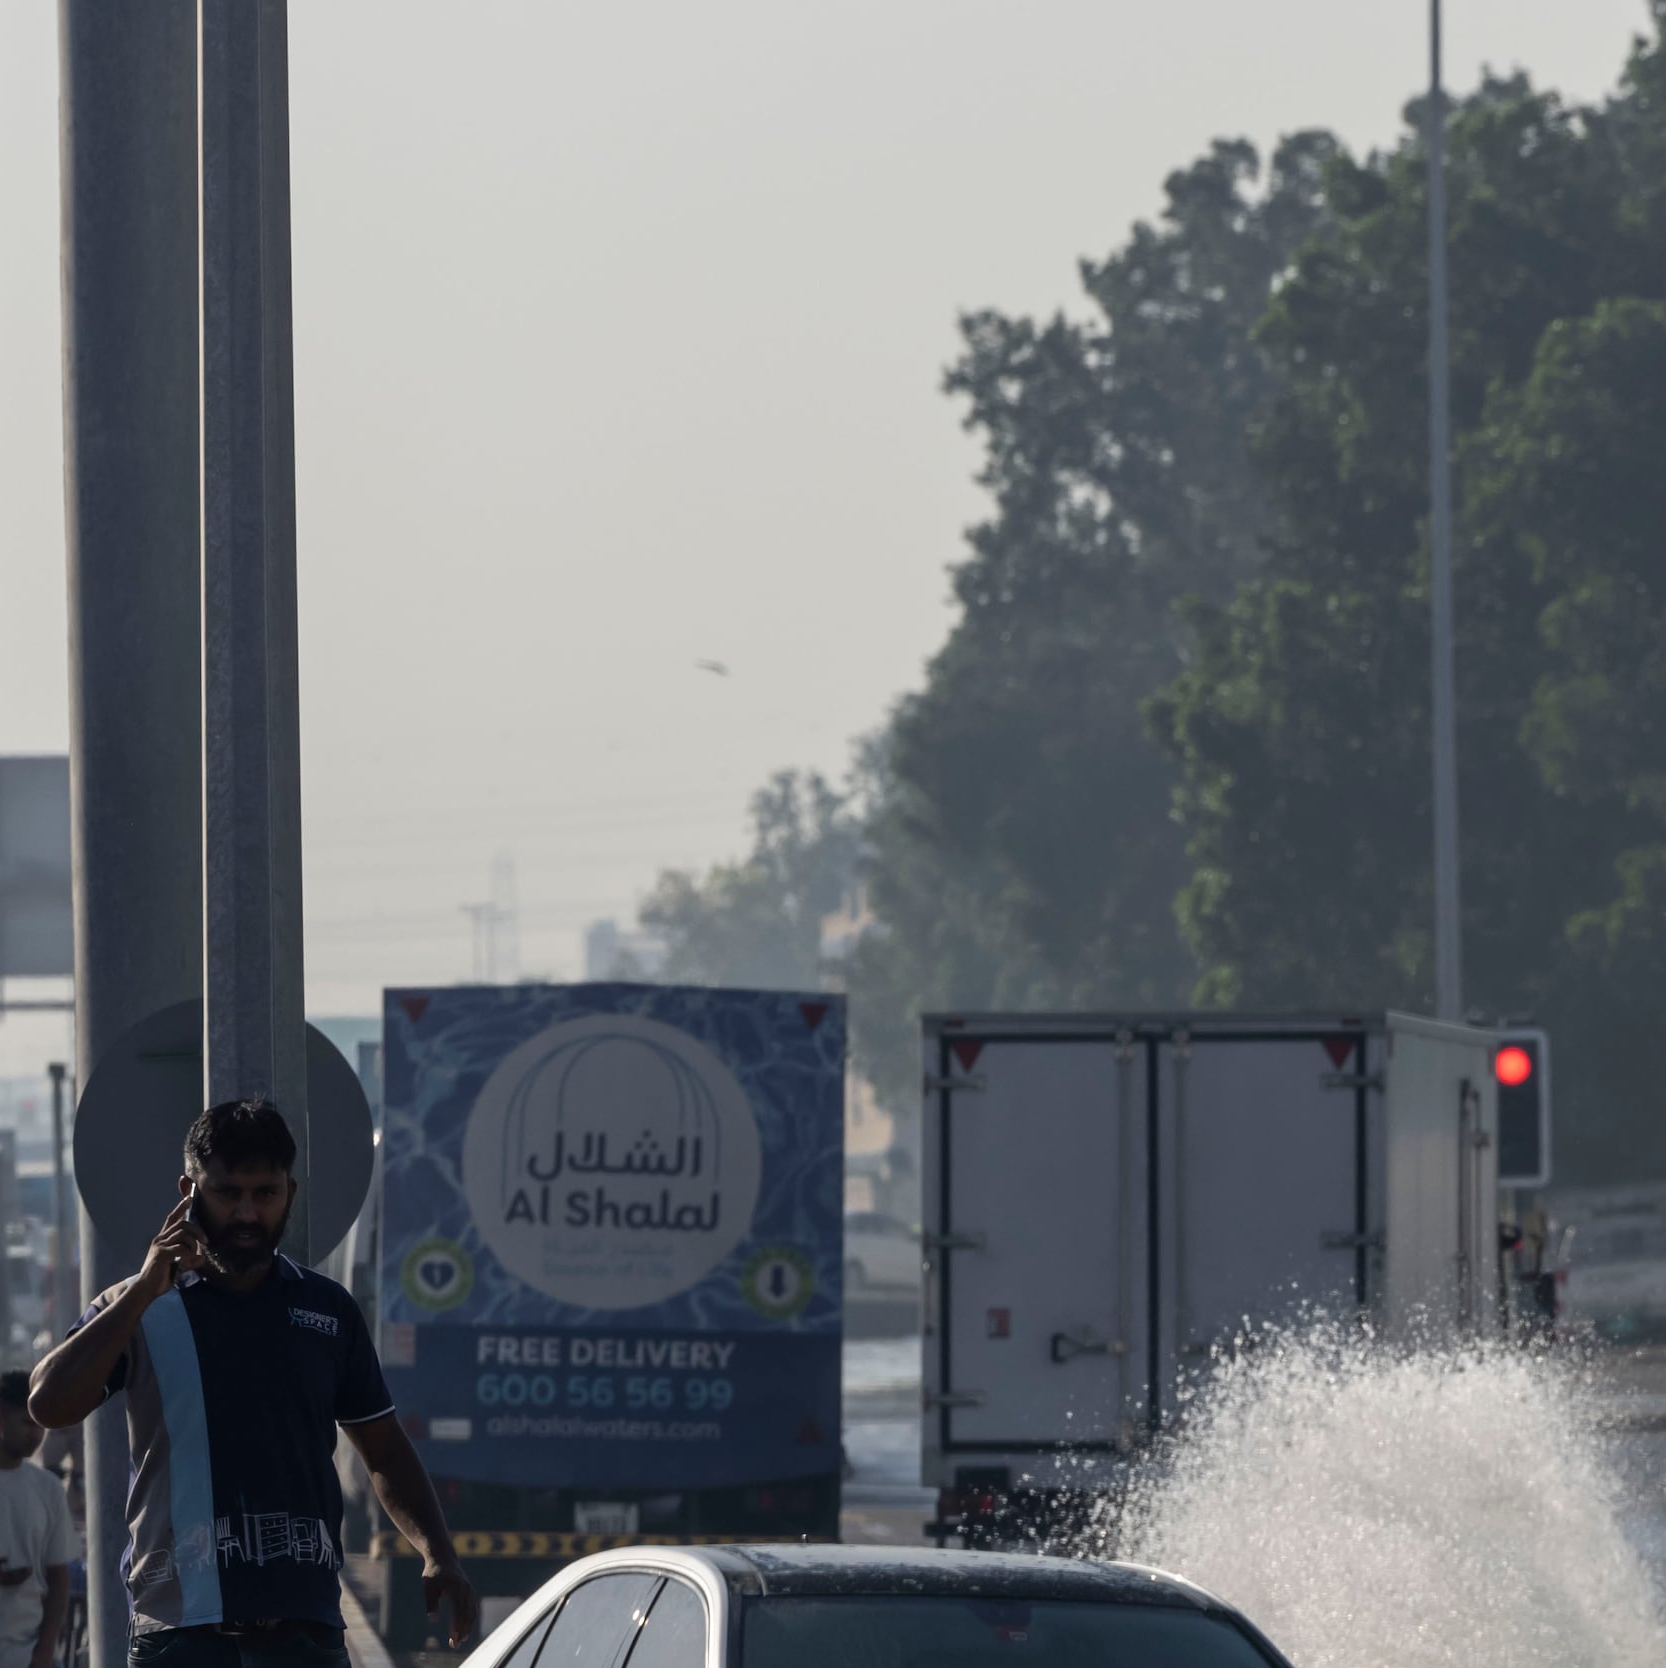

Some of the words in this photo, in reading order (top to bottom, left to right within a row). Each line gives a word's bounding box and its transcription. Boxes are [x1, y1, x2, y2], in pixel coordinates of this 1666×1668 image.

[527, 1129, 703, 1182] الشلال
[504, 1184, 550, 1226] Al
[564, 1185, 721, 1232] Shalal
[477, 1336, 562, 1367] FREE
[569, 1338, 737, 1370] DELIVERY
[476, 1373, 557, 1407] 600
[566, 1376, 616, 1407] 56
[624, 1376, 674, 1409] 56
[683, 1377, 735, 1410] 99
[486, 1414, 722, 1442] alshalalwaters.com
